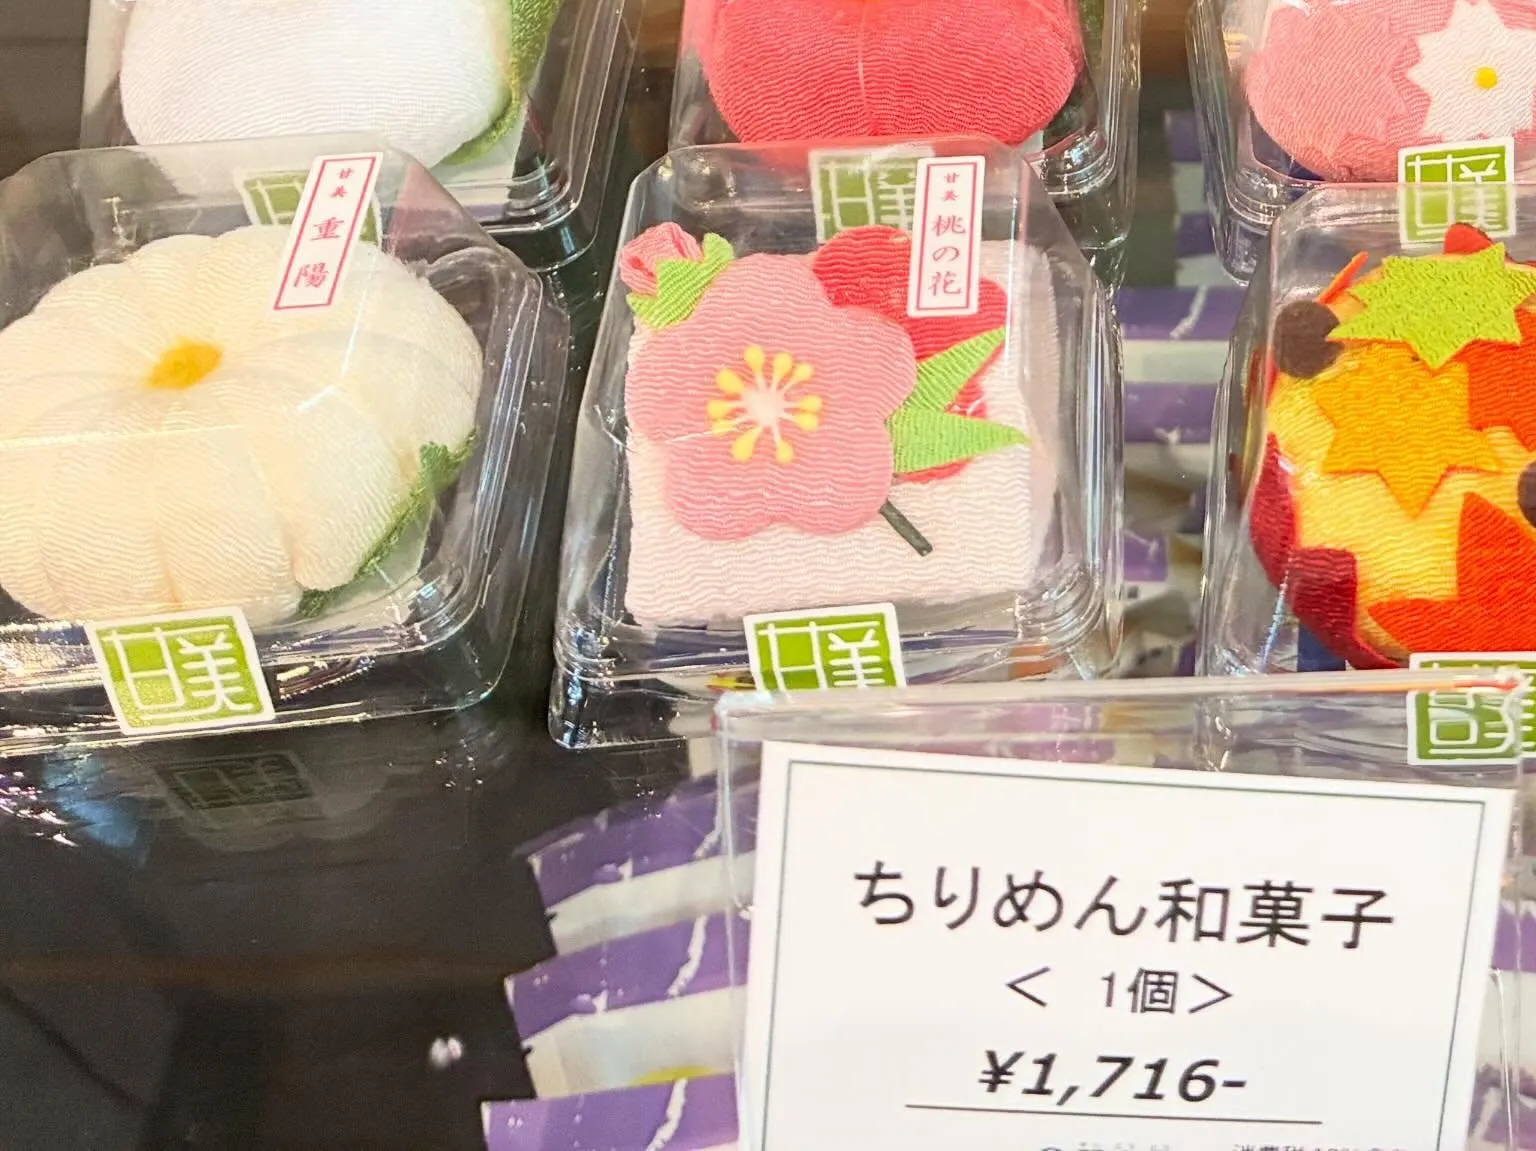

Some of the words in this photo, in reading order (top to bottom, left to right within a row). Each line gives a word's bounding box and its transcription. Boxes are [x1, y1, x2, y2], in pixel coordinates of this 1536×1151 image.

[293, 216, 345, 288] 重陽
[928, 214, 967, 296] 桃の花
[854, 860, 1394, 952] ちりめん和菓子
[979, 1049, 1248, 1106] ¥1,716-
